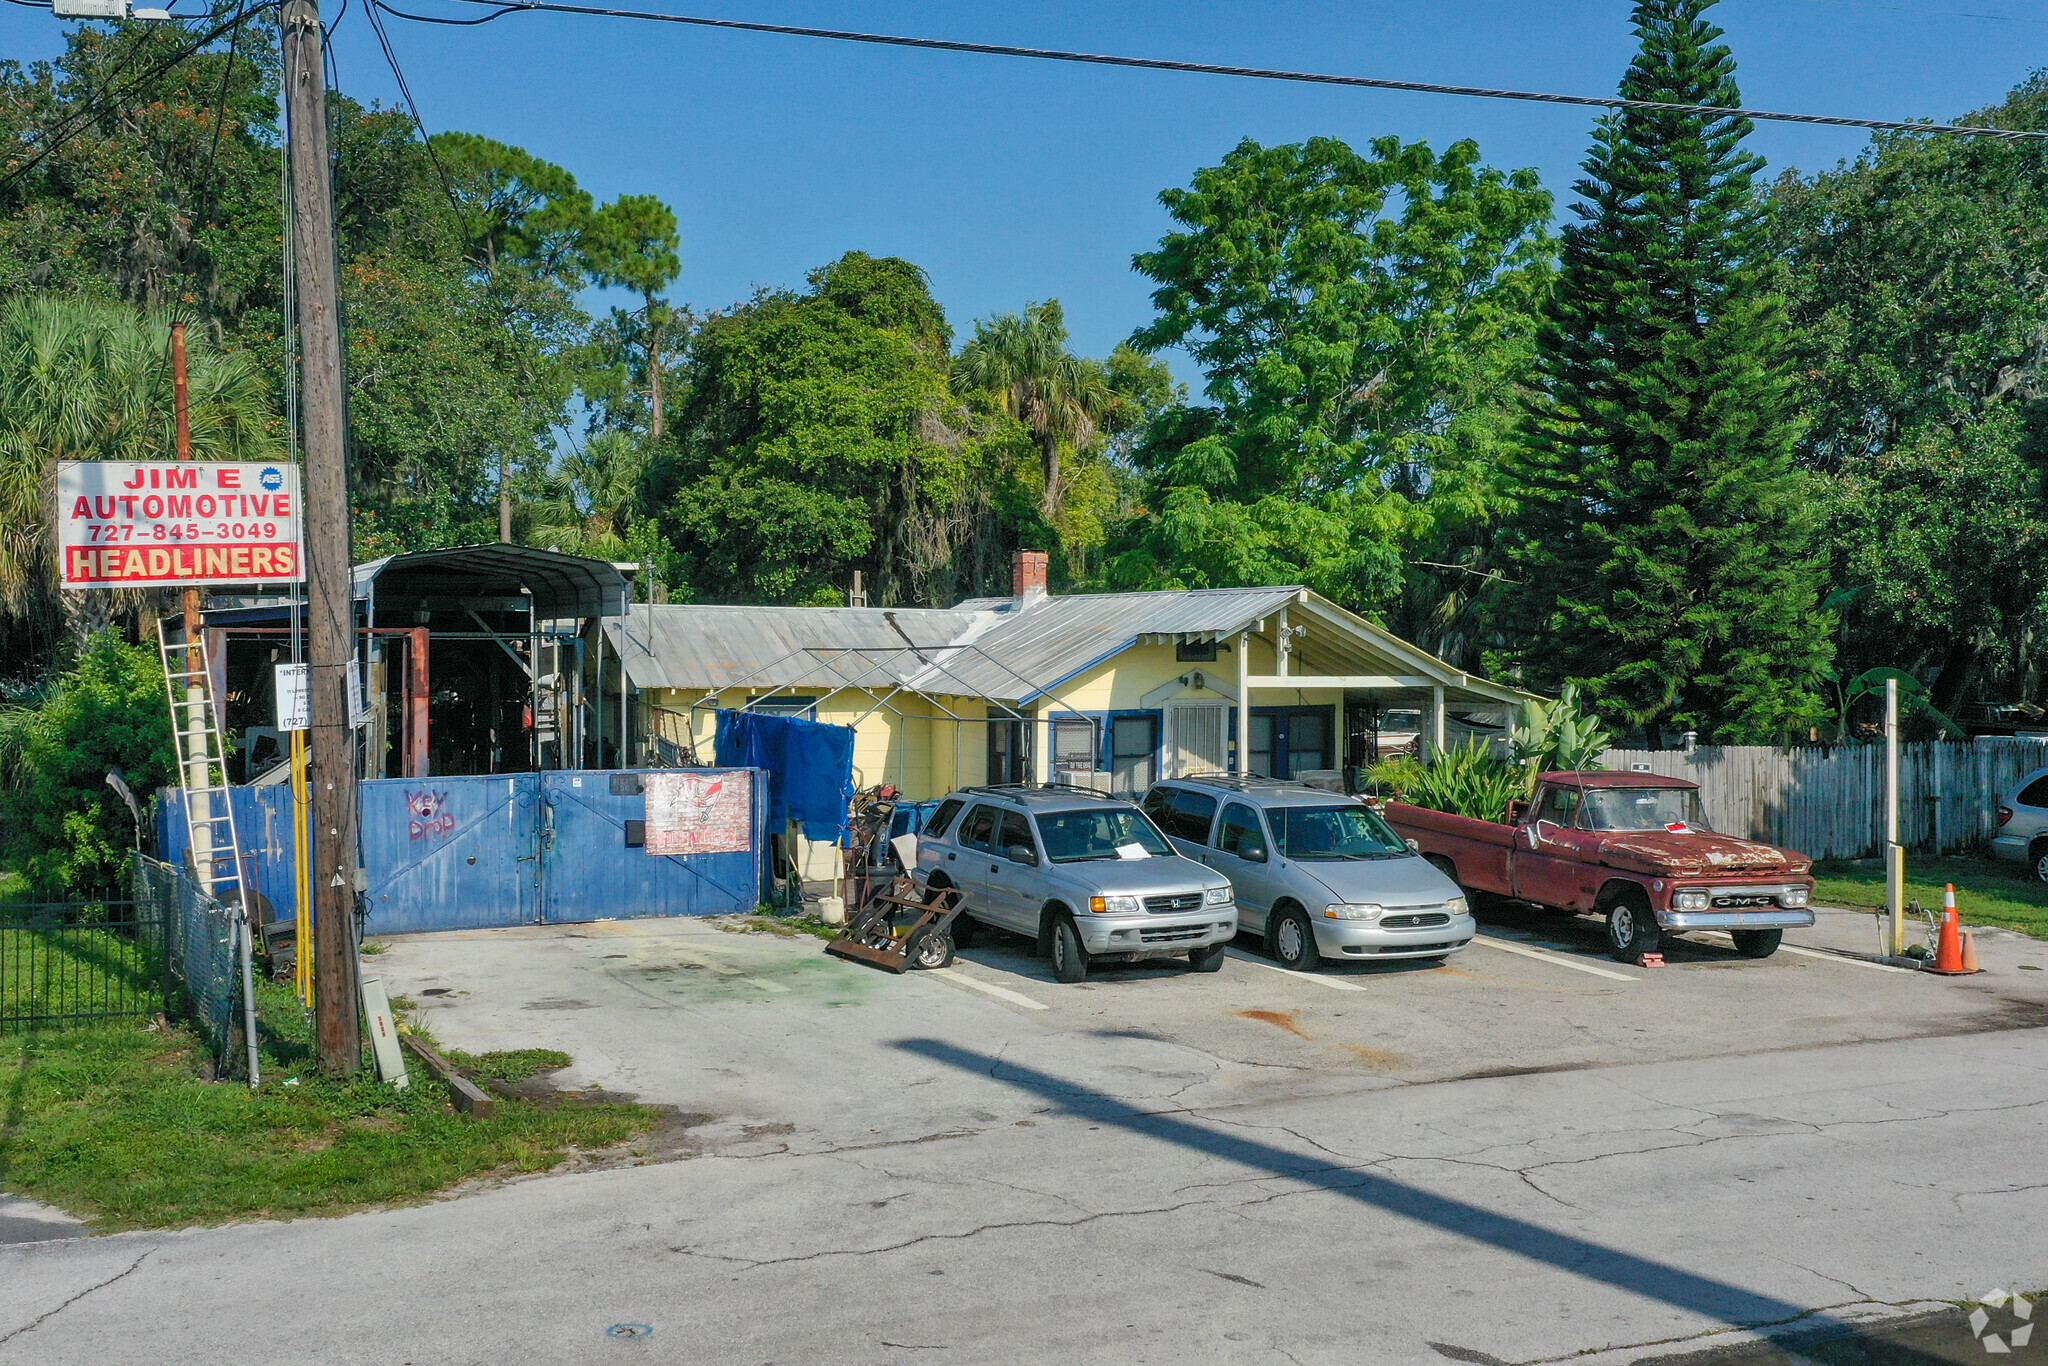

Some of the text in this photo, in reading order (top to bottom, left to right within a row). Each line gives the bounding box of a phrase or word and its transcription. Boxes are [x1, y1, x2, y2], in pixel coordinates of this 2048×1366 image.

[123, 468, 242, 489] JIM E
[262, 474, 281, 484] ASE
[71, 494, 291, 520] AUTOMOTIVE
[87, 522, 277, 542] 727-845-3049
[71, 546, 294, 578] HEADLINERS
[1716, 896, 1770, 905] GMC
